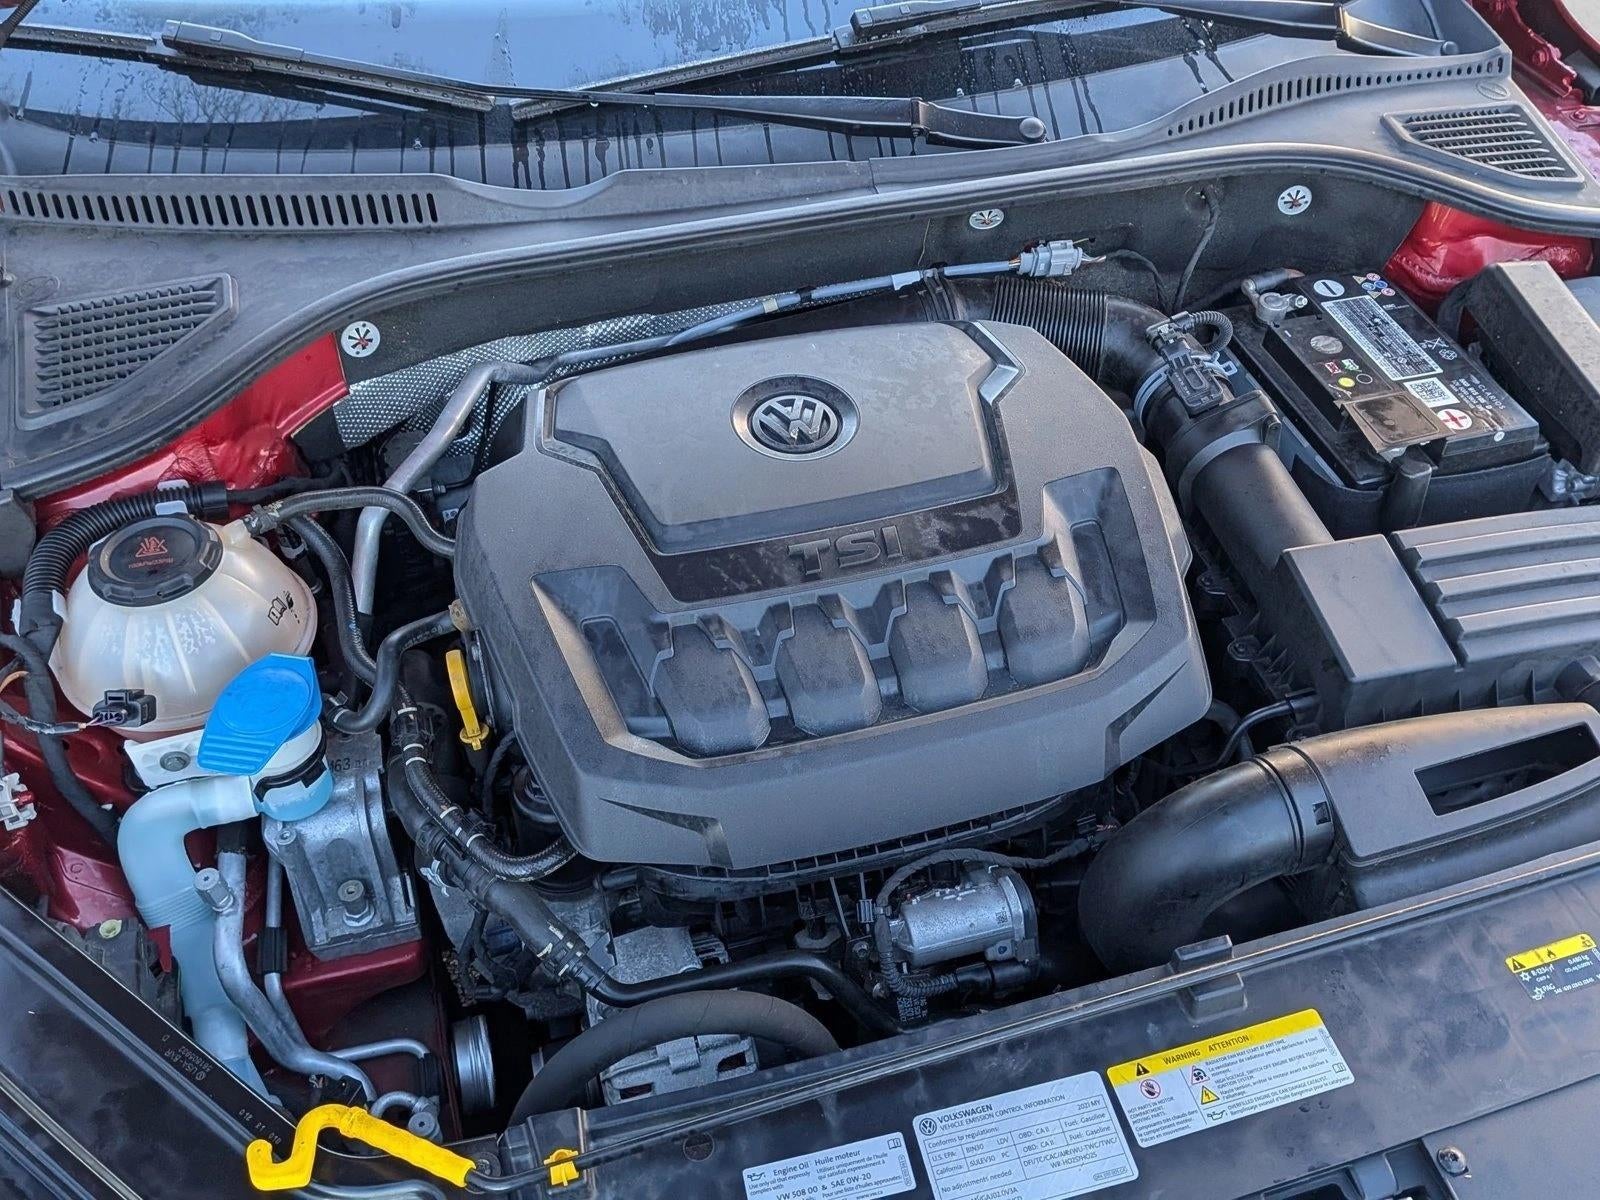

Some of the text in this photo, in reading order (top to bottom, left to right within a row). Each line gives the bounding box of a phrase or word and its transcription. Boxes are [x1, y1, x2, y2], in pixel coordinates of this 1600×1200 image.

[787, 525, 904, 576] TSI
[1542, 983, 1556, 992] PAG
[1163, 1035, 1249, 1064] WARNING ATTENTION
[938, 1104, 993, 1123] VOLKSWAGEN
[940, 1094, 1065, 1131] VEHICLE EMISSION CONTROL INFORMATION
[1077, 1102, 1090, 1110] 2021
[996, 1136, 1009, 1145] LDV
[1080, 1111, 1106, 1123] Gasoline
[1069, 1132, 1082, 1140] Fuel:
[1085, 1124, 1110, 1136] Gasoline
[928, 1136, 956, 1148] Conforms
[814, 1149, 860, 1166] Huile moteur
[773, 1161, 809, 1177] Engine Oil
[791, 1188, 806, 1197] 508
[807, 1185, 818, 1193] 00
[830, 1179, 845, 1188] SAE
[846, 1172, 871, 1184] 0W-20
[952, 1175, 989, 1192] adjustments
[989, 1169, 1012, 1180] needed
